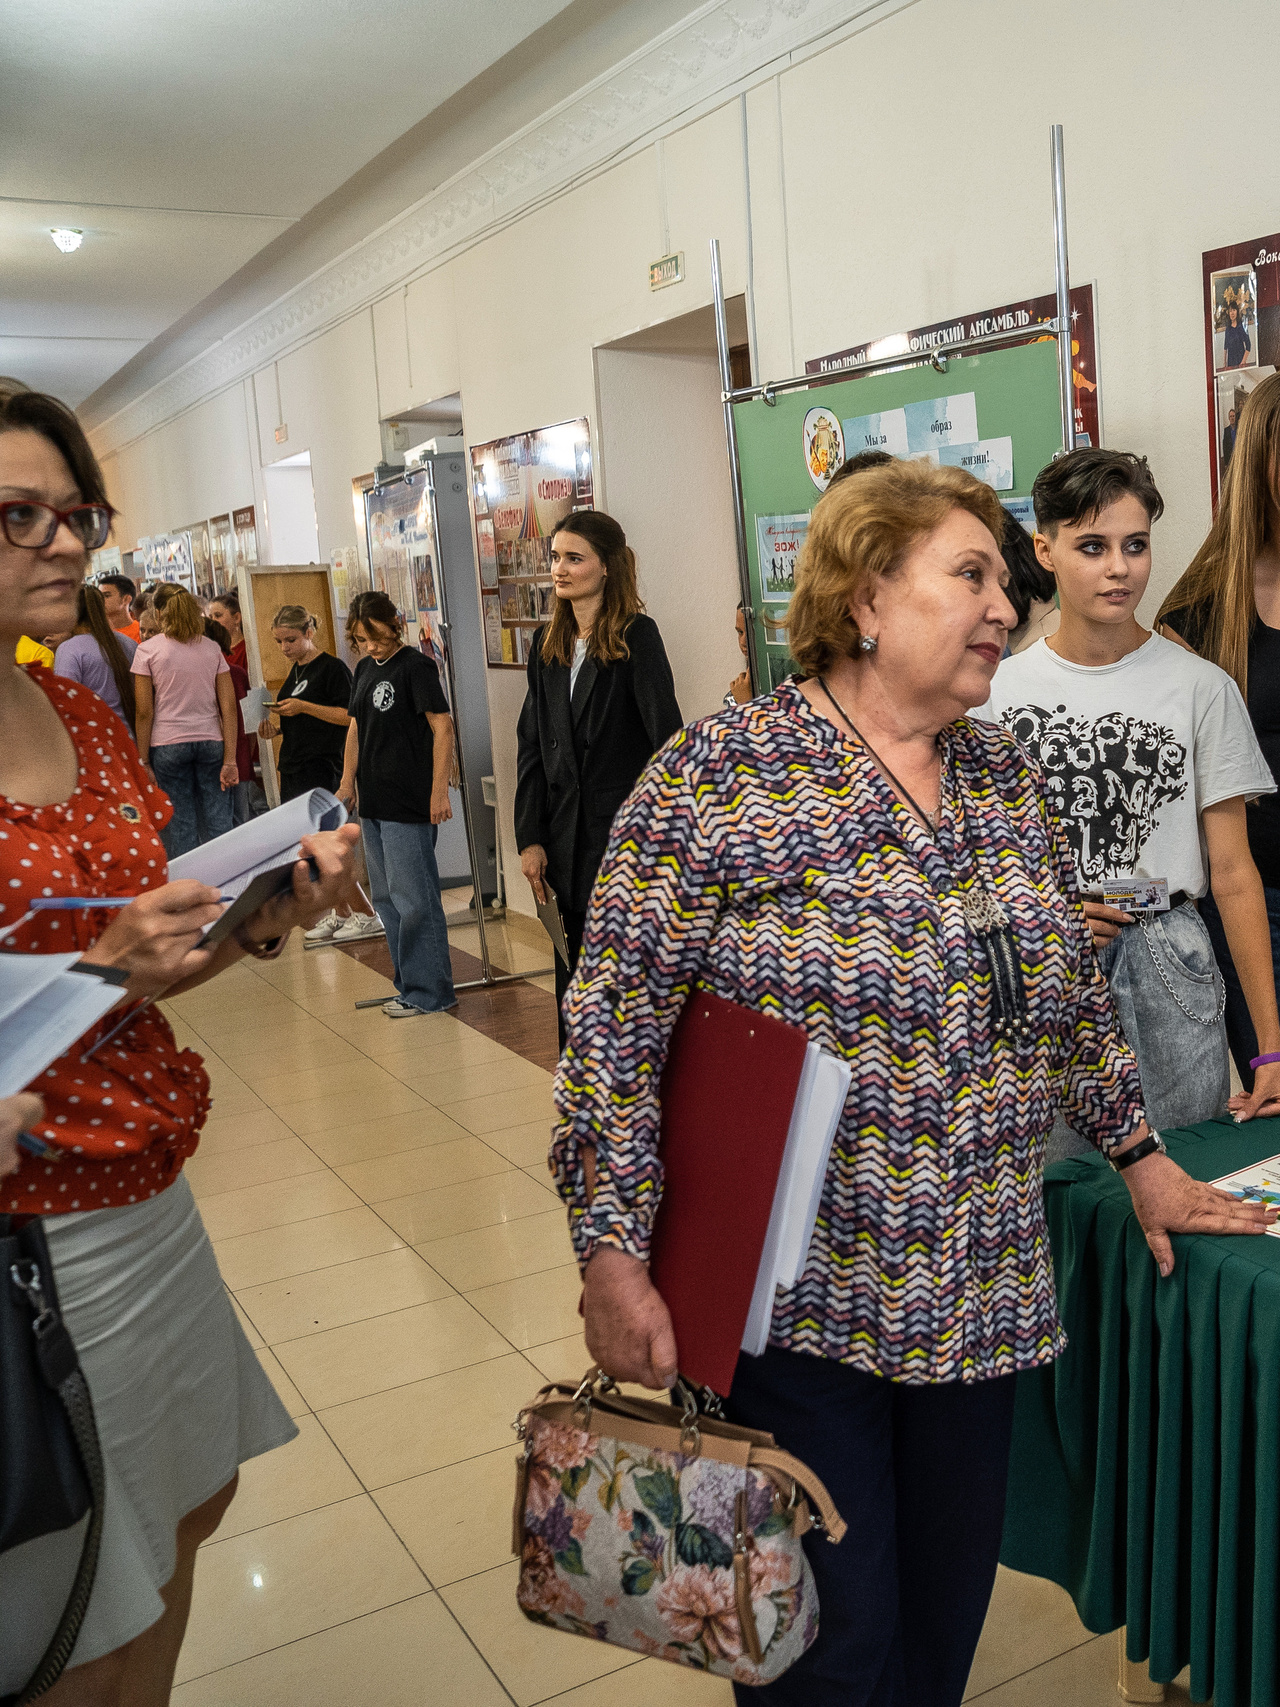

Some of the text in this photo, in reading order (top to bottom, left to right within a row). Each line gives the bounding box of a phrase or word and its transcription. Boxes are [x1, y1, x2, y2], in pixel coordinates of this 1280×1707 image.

[910, 322, 965, 351] ФИЧЕСКИЙ
[969, 310, 1030, 338] АНСАМБЛЬ
[930, 420, 953, 435] образ
[865, 434, 888, 447] Мы за
[961, 450, 990, 467] жизни!
